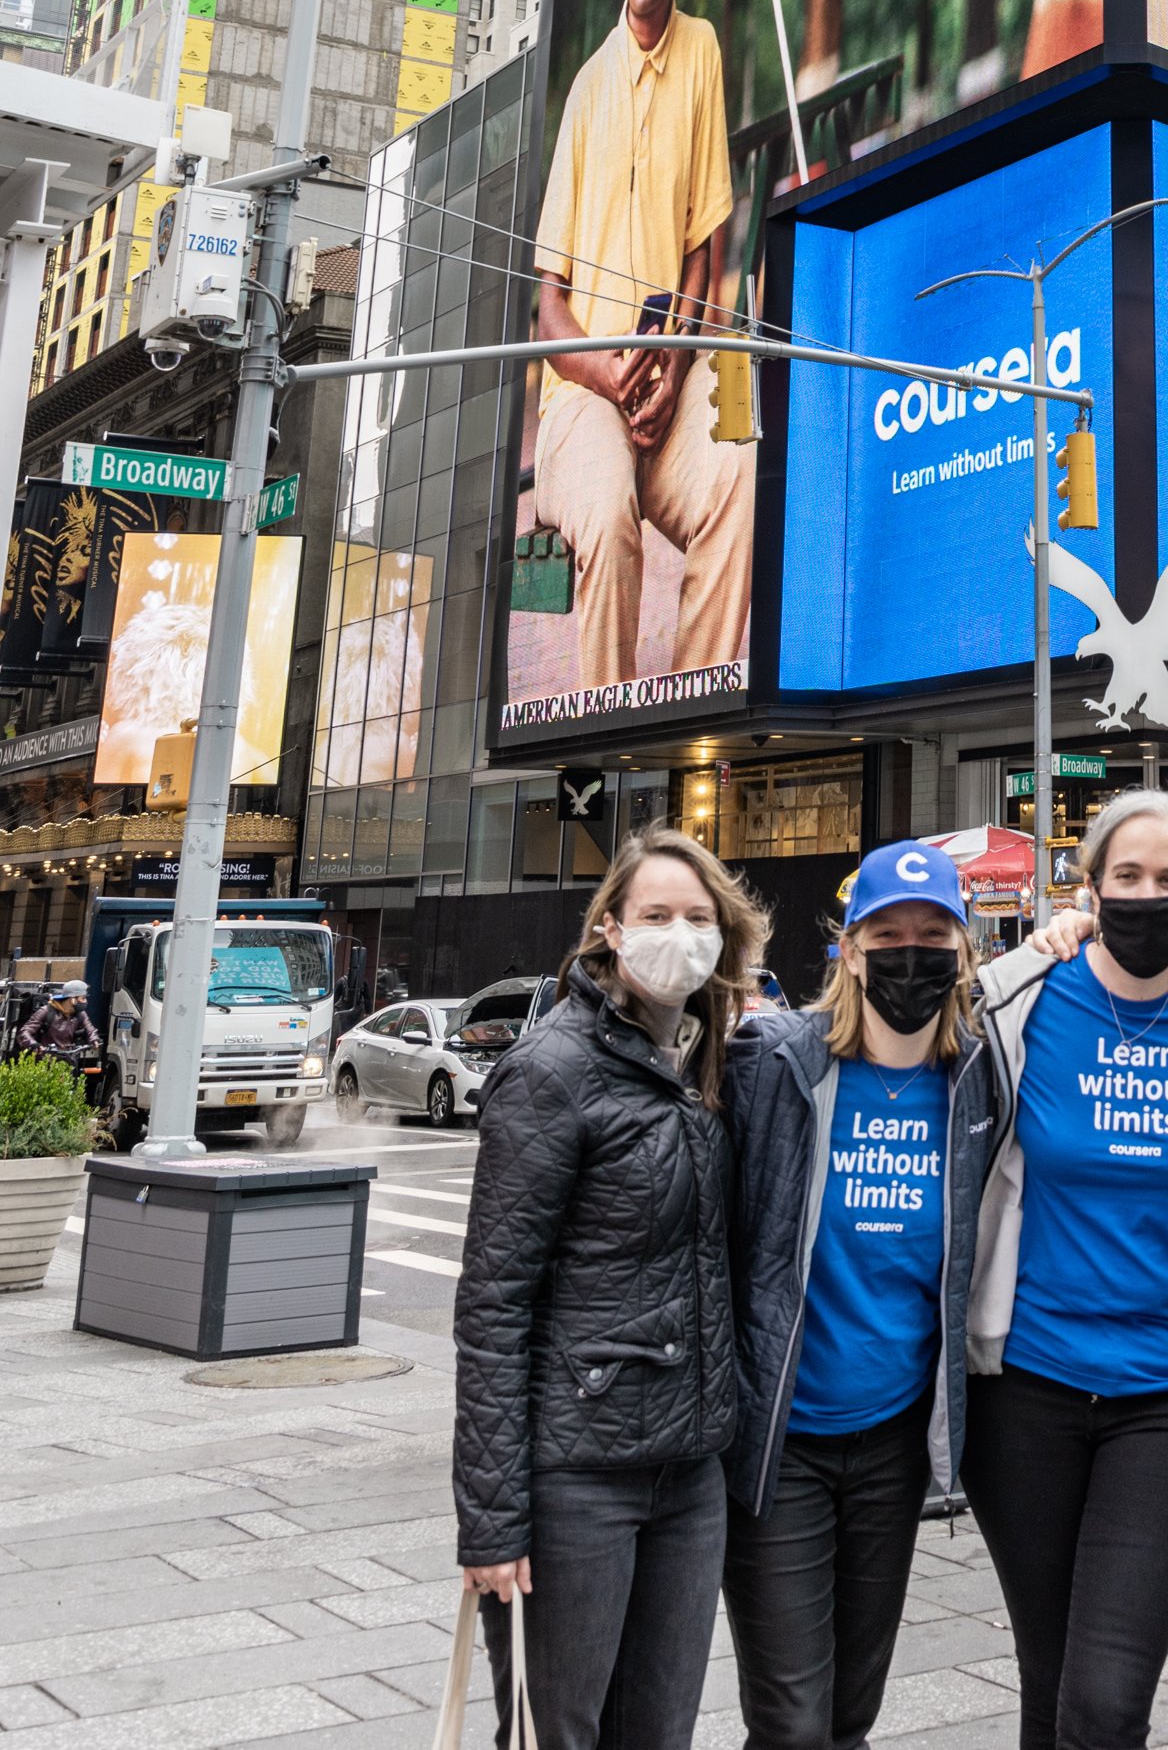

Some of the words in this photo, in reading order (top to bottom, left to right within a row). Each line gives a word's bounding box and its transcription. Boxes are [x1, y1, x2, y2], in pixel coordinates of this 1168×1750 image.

[188, 233, 238, 257] 726162
[100, 452, 221, 500] Broadway
[891, 463, 935, 496] Learn
[937, 445, 1004, 480] without
[1005, 428, 1057, 465] lims
[258, 493, 270, 524] W
[270, 484, 286, 514] 46
[287, 481, 298, 502] St
[500, 692, 581, 732] AMERICAN
[583, 680, 633, 716] EAGLE
[636, 661, 743, 707] OUTFITTERS
[12, 734, 49, 763] AUDIENCE
[48, 729, 68, 754] WITH
[67, 725, 85, 749] THIS
[1012, 779, 1020, 793] W
[1020, 775, 1030, 792] 46
[1061, 757, 1104, 779] Broadway
[229, 873, 251, 881] ADORE
[896, 851, 931, 884] C
[995, 881, 1022, 891] thirsty?
[223, 1034, 264, 1045] ISUZU
[852, 1111, 929, 1143] Learn
[832, 1144, 941, 1178] without
[1108, 1143, 1162, 1157] coursera
[844, 1178, 924, 1211] limits
[854, 1219, 905, 1234] coursera
